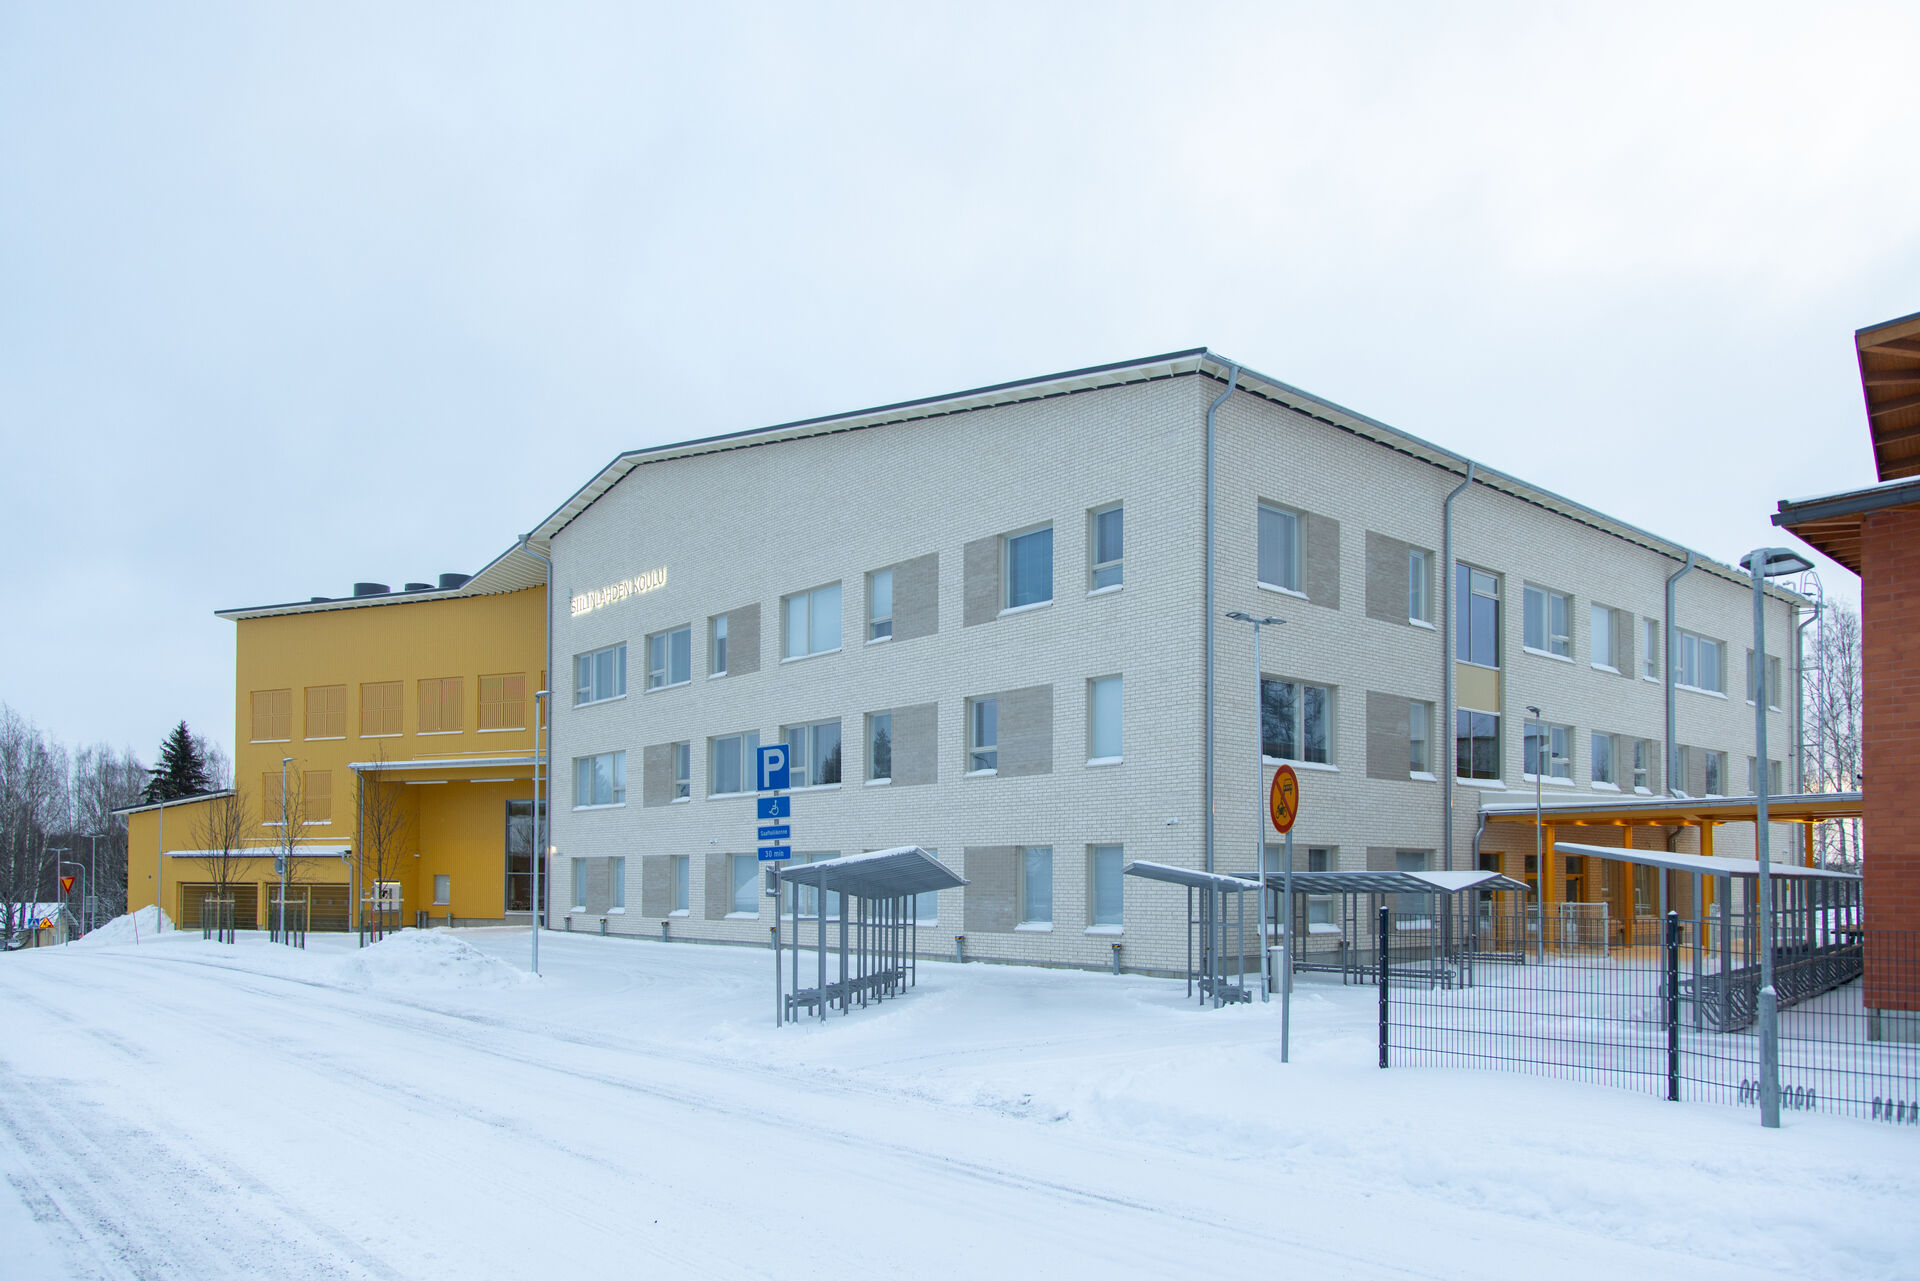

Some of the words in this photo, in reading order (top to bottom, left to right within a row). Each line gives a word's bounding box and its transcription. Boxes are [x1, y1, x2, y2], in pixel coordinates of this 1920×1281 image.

[633, 566, 667, 594] KOULU
[763, 748, 785, 788] P
[765, 850, 773, 858] 30
[774, 849, 784, 857] min
